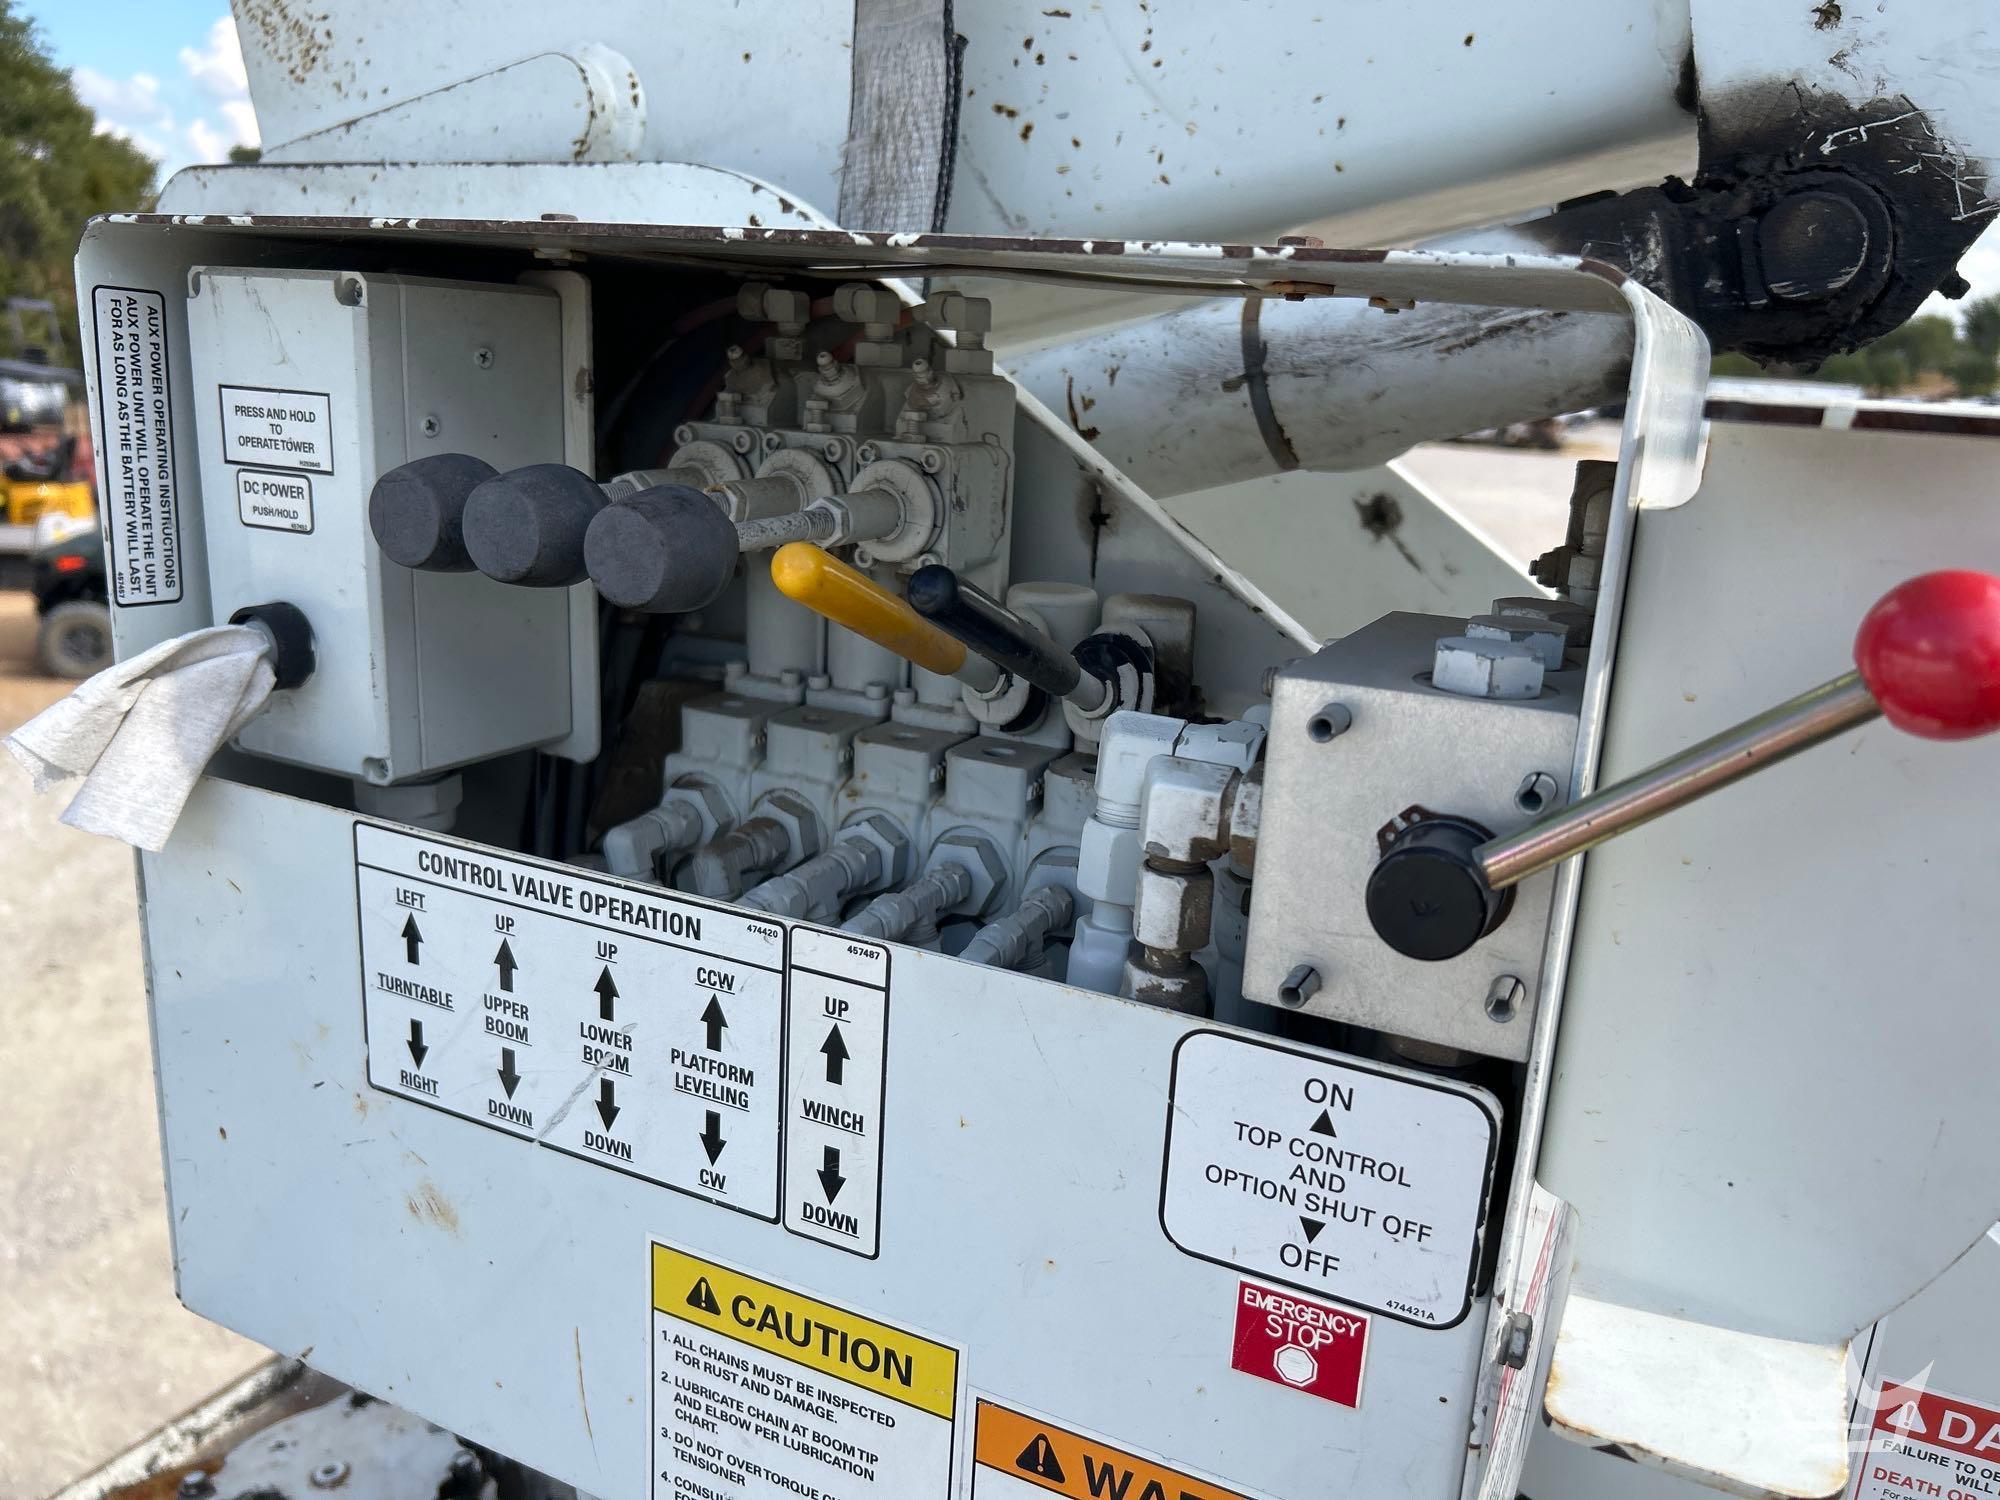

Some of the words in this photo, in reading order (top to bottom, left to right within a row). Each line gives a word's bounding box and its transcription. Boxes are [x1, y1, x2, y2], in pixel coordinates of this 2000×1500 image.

[110, 298, 122, 328] FOR
[126, 296, 140, 328] AUX
[147, 306, 160, 338] AUX
[112, 331, 124, 352] AS
[129, 332, 143, 386] POWER
[150, 342, 163, 395] POWER
[114, 356, 128, 398] LONG
[117, 401, 130, 420] AS
[133, 392, 146, 424] UNIT
[234, 405, 264, 418] PRESS
[266, 408, 287, 421] AND
[290, 410, 316, 423] HOLD
[120, 423, 132, 451] THE
[136, 429, 148, 462] WILL
[154, 400, 169, 480] OPERATING
[238, 436, 281, 451] OPERATE
[280, 440, 315, 454] TOWER
[270, 423, 283, 436] TO
[122, 456, 137, 518] BATTERY
[138, 467, 152, 527] OPERATE
[244, 480, 260, 494] DC
[262, 482, 304, 500] POWER
[252, 505, 298, 520] PUSH/HOLD
[126, 520, 139, 555] WILL
[142, 532, 154, 560] THE
[160, 484, 176, 588] INSTRUCTIONS
[129, 558, 142, 595] LAST.
[145, 564, 157, 597] UNIT
[396, 887, 426, 909] LEFT
[418, 850, 507, 892] CONTROL
[511, 873, 574, 909] VALVE
[579, 889, 702, 941] OPERATION
[495, 914, 515, 932] UP
[746, 924, 778, 938] 474420
[597, 940, 618, 959] UP
[846, 945, 880, 960] 457487
[378, 972, 454, 1008] TURNTABLE
[696, 966, 735, 990] CCW
[484, 994, 530, 1021] UPPER
[824, 996, 850, 1017] UP
[486, 1015, 529, 1042] BOOM
[580, 1022, 632, 1052] LOWER
[583, 1045, 630, 1072] BOOM
[671, 1048, 754, 1087] PLATFORM
[401, 1070, 438, 1094] RIGHT
[675, 1072, 750, 1109] LEVELING
[1304, 1078, 1354, 1112] ON
[488, 1098, 532, 1126] DOWN
[802, 1098, 864, 1132] WINCH
[584, 1130, 632, 1159] DOWN
[1234, 1121, 1282, 1150] TOP
[1288, 1138, 1411, 1188] CONTROL
[700, 1168, 726, 1190] CW
[1289, 1164, 1346, 1194] AND
[802, 1201, 858, 1235] DOWN
[1205, 1164, 1296, 1206] OPTION
[1304, 1194, 1376, 1228] SHUT
[1383, 1216, 1432, 1242] OFF
[1279, 1244, 1340, 1278] OFF
[1244, 1288, 1362, 1337] EMERGENCY
[1386, 1300, 1434, 1320] 474421A
[732, 1295, 912, 1387] CAUTION
[1265, 1317, 1333, 1350] STOP
[662, 1330, 672, 1343] 1.
[673, 1335, 696, 1352] ALL
[700, 1344, 750, 1372] CHAINS
[753, 1363, 793, 1388] MUST
[796, 1382, 814, 1397] BE
[818, 1389, 896, 1428] INSPECTED
[676, 1350, 700, 1370] FOR
[704, 1360, 738, 1382] RUST
[740, 1378, 770, 1396] AND
[774, 1390, 838, 1424] DAMAGE.
[661, 1371, 672, 1384] 2.
[675, 1376, 744, 1412] LUBRICATE
[748, 1406, 790, 1431] CHAIN
[792, 1422, 810, 1437] AT
[812, 1430, 855, 1456] BOOM
[857, 1448, 880, 1466] TIP
[674, 1408, 719, 1434] CHART.
[674, 1392, 702, 1410] AND
[705, 1405, 751, 1432] ELBOW
[755, 1426, 780, 1444] PER
[783, 1438, 874, 1482] LUBRICATION
[661, 1427, 672, 1440] 3.
[674, 1431, 694, 1448] DO
[696, 1440, 724, 1460] NOT
[726, 1455, 762, 1477] OVER
[764, 1468, 819, 1500] TORQUE
[673, 1447, 746, 1486] TENSIONER
[1882, 1440, 1950, 1468] FAILURE
[1954, 1460, 1976, 1474] TO
[661, 1470, 672, 1483] 4.
[1873, 1467, 1942, 1498] DEATH
[1956, 1474, 1993, 1494] WILL
